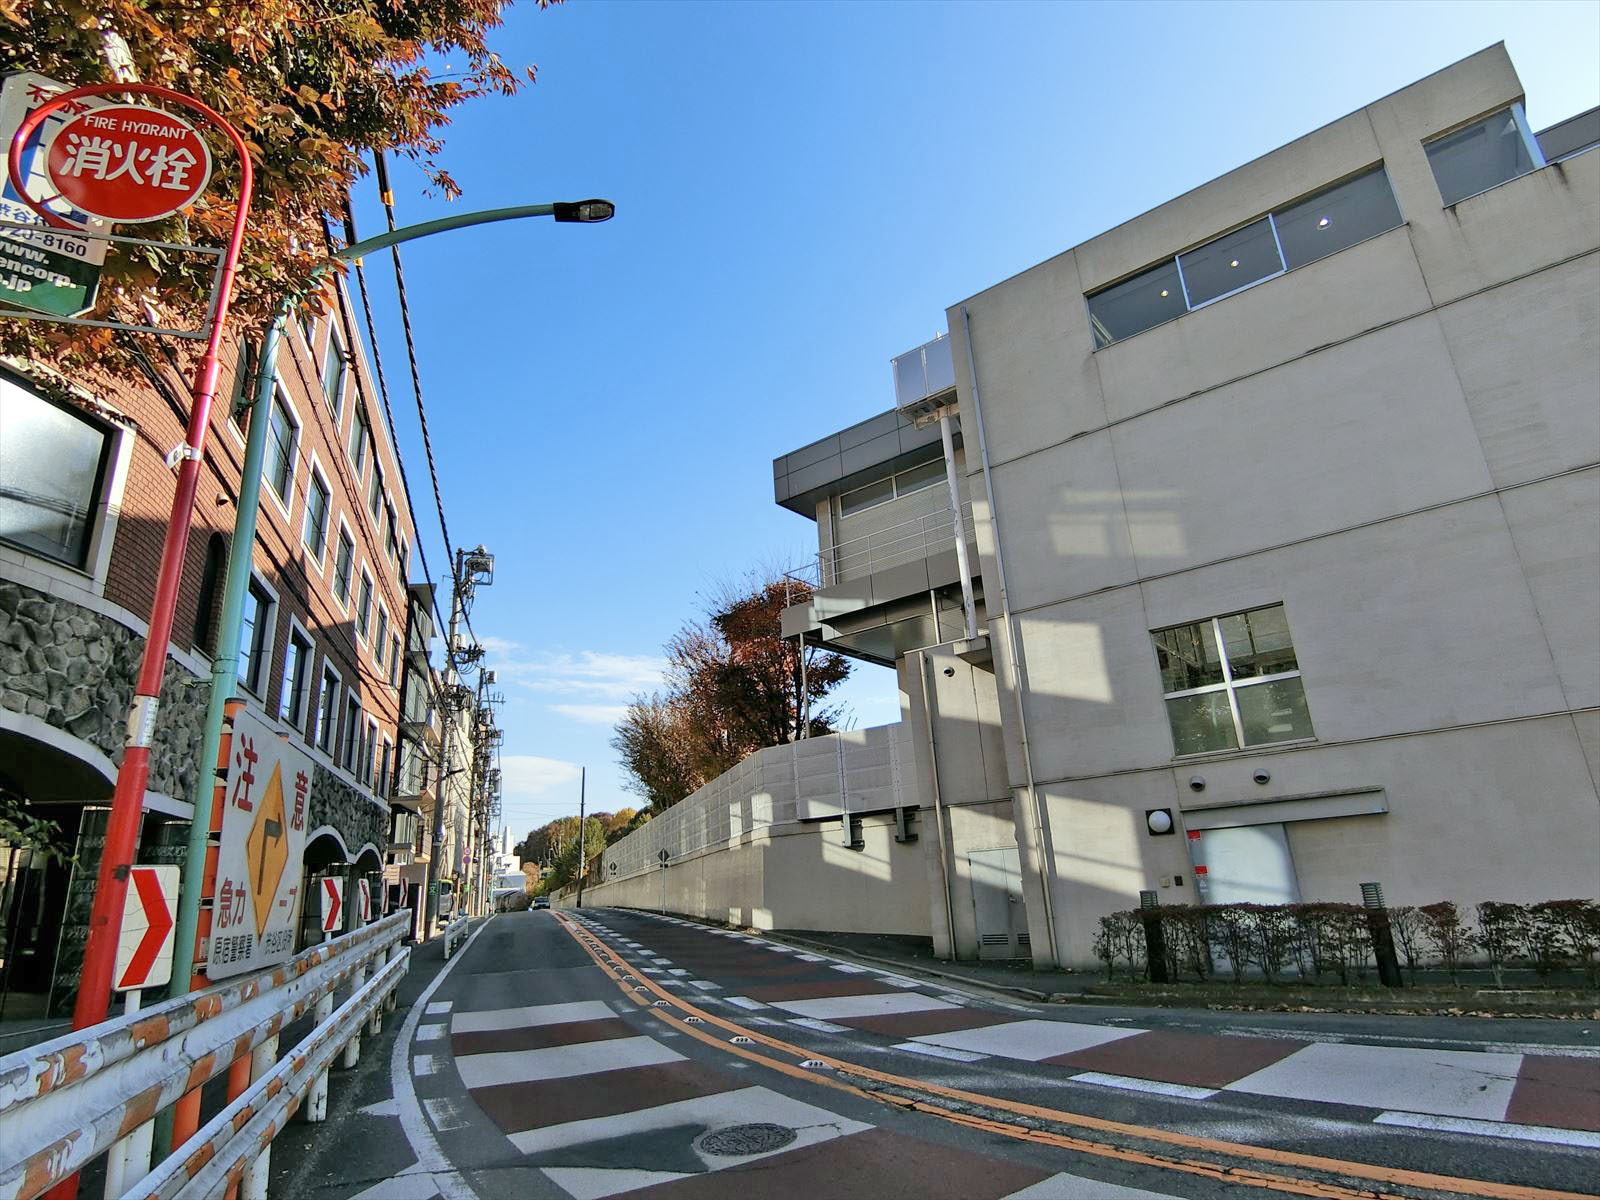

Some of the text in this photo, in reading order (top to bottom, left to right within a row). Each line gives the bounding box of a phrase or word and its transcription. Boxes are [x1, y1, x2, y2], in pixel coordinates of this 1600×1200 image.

[84, 115, 189, 140] FIRE HYDRANT
[59, 132, 198, 191] 消火栓
[0, 241, 50, 265] ww.
